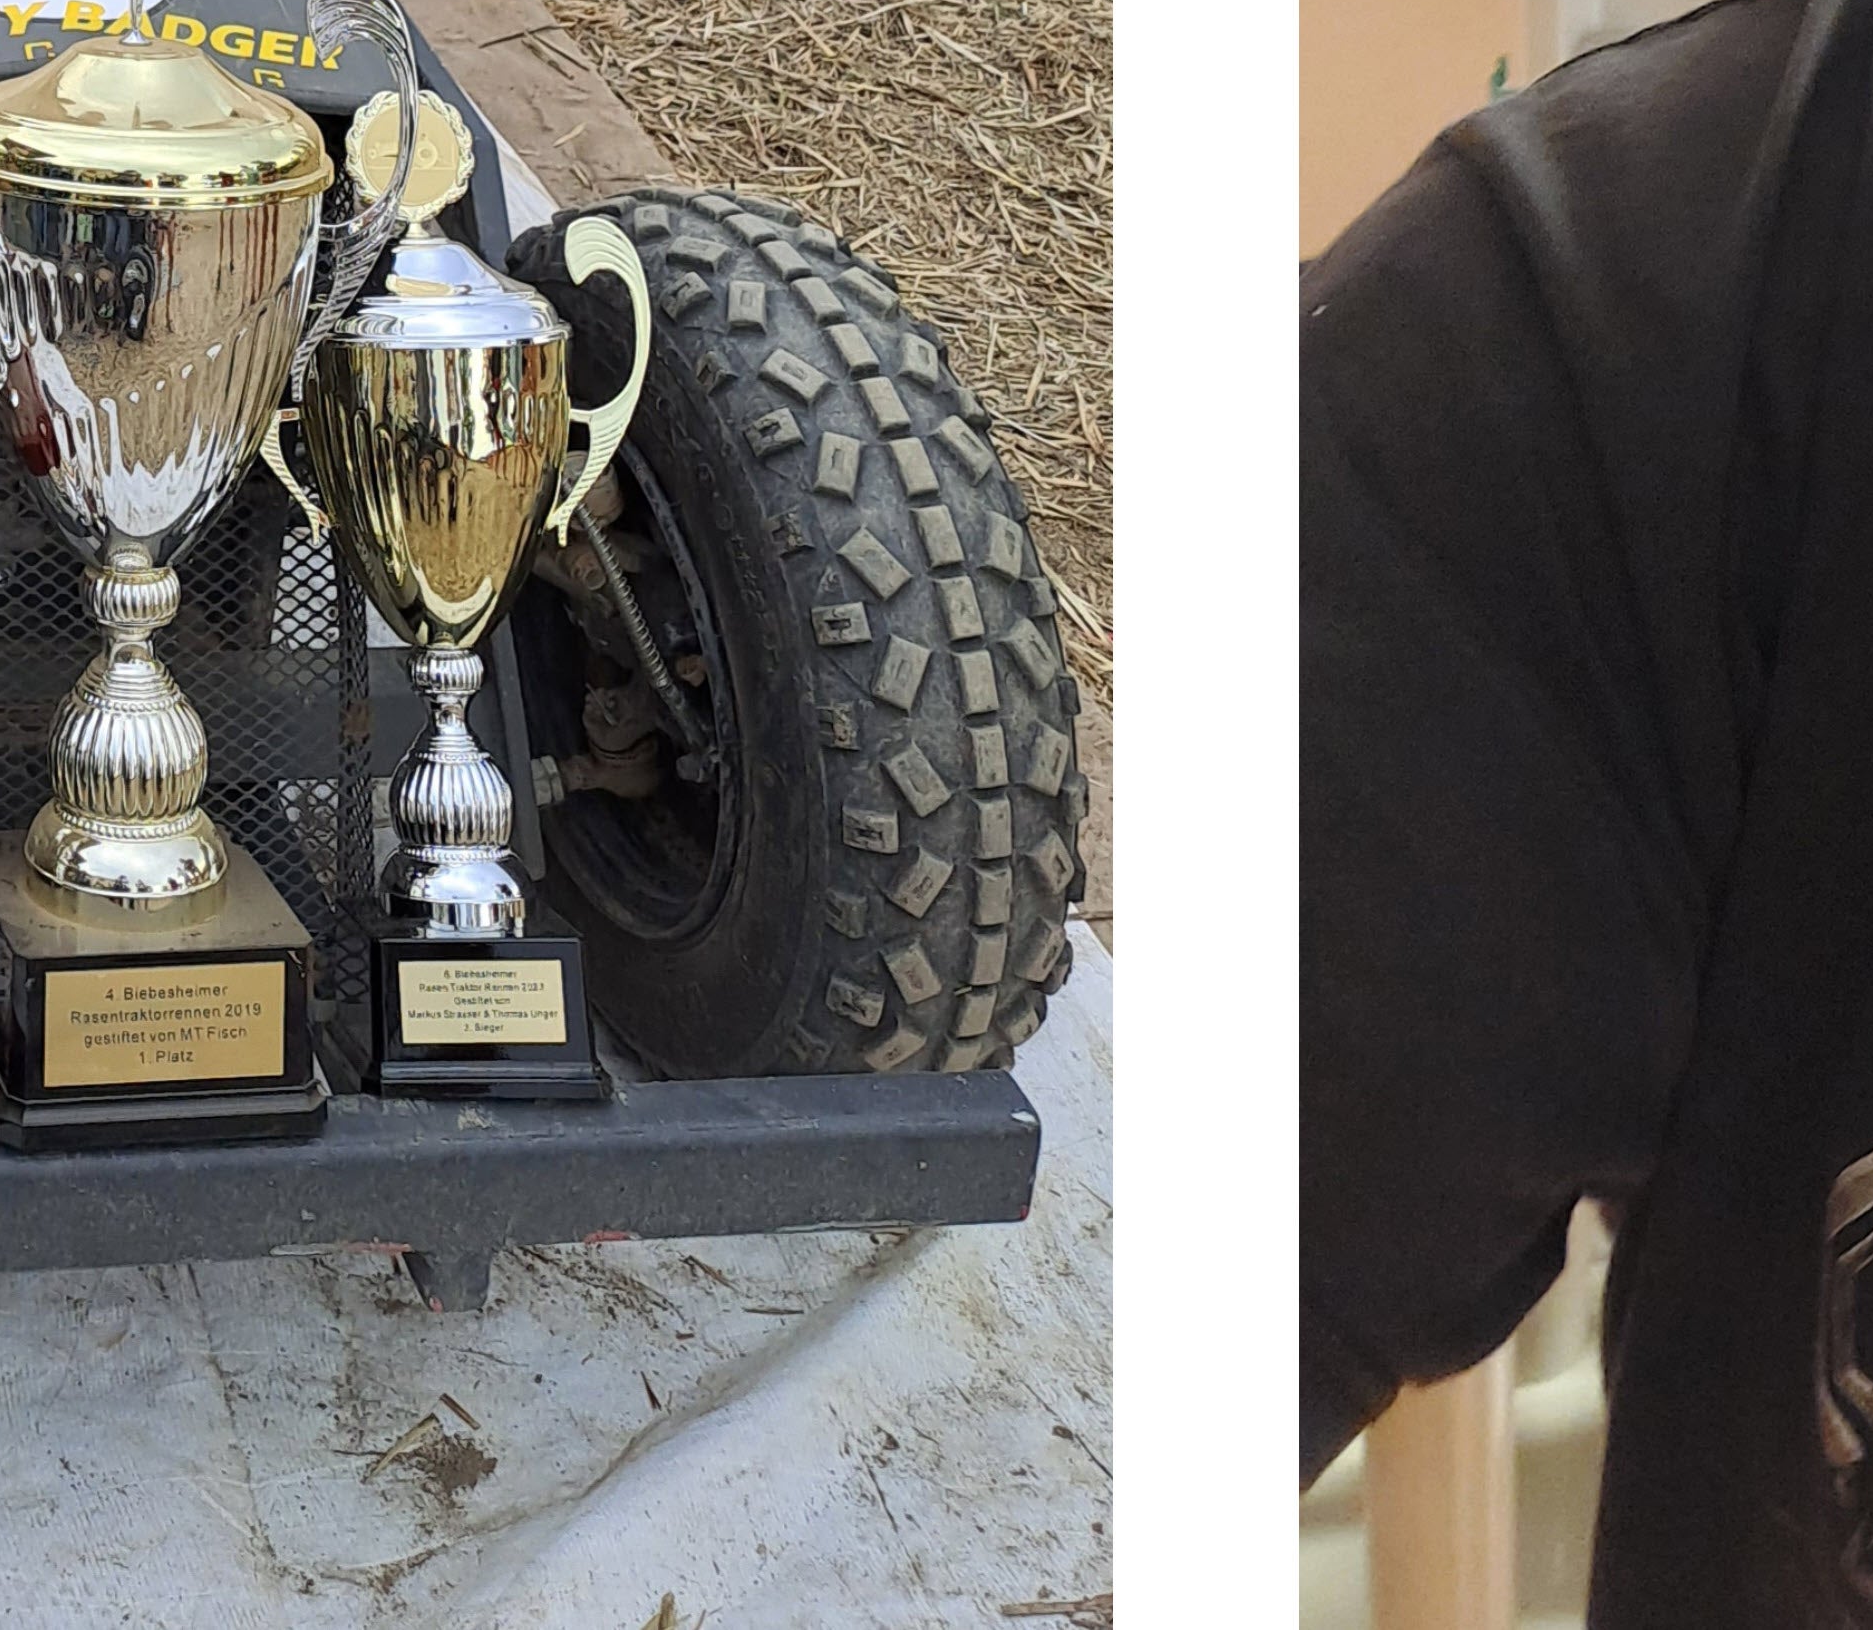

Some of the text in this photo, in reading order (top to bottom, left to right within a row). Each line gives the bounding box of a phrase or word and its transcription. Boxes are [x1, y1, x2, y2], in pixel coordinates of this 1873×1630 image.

[123, 984, 229, 1001] Biebesheimer
[70, 1002, 262, 1024] Rasentraktorrennen 2019
[84, 1030, 146, 1048] gestiftet
[149, 1031, 176, 1043] von
[206, 1025, 248, 1039] Fisch
[155, 1050, 195, 1063] Platz
